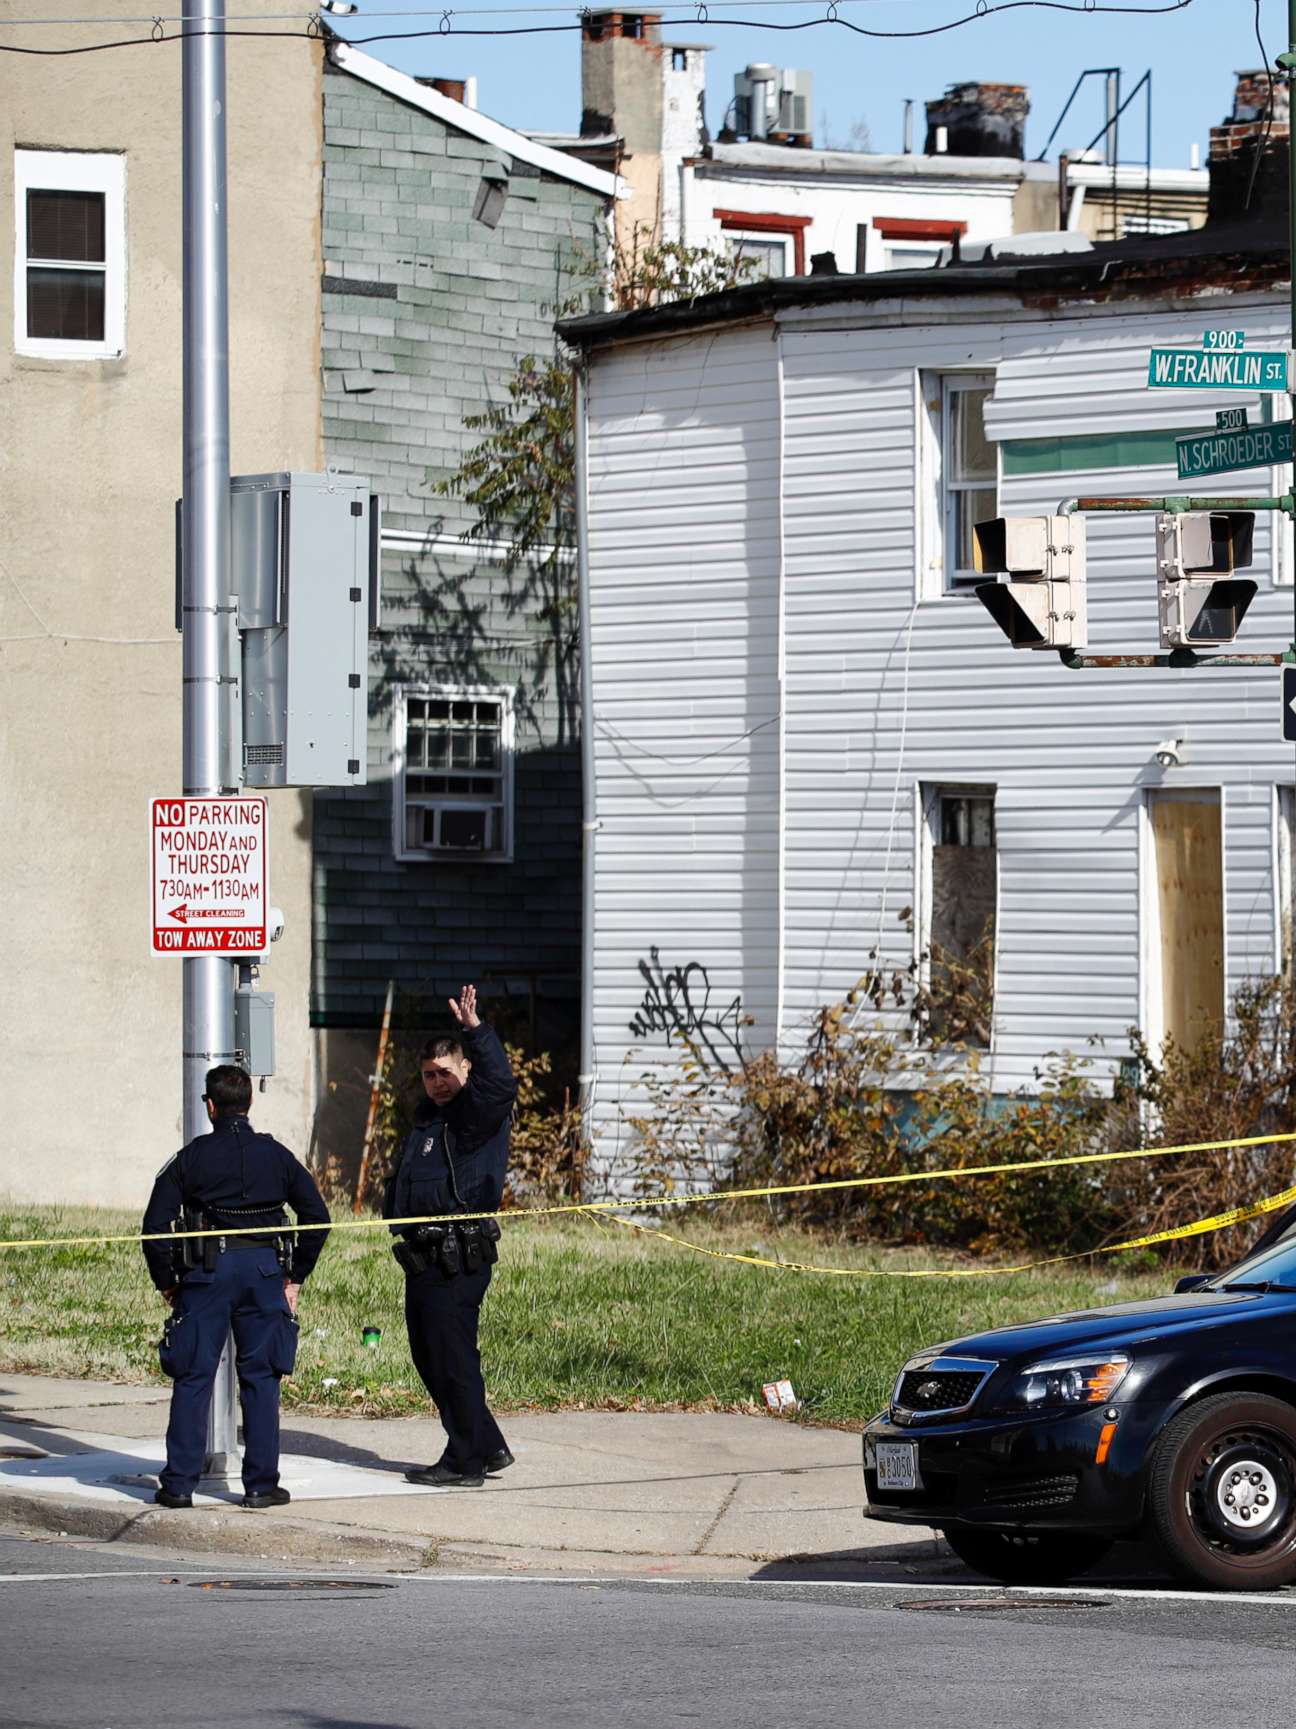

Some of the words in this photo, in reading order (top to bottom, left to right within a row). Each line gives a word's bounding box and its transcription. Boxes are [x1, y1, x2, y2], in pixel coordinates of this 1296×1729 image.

[1208, 331, 1237, 349] 900
[1265, 362, 1283, 380] ST.
[1221, 409, 1243, 429] 500
[155, 803, 184, 826] NO
[189, 804, 261, 825] PARKING
[160, 830, 228, 851] MONDAY
[228, 835, 258, 851] AND
[168, 854, 250, 875] THURSDAY
[175, 910, 205, 918] STREET
[205, 909, 245, 918] CLEANING
[156, 930, 184, 948] TOW
[186, 930, 225, 948] AWAY
[227, 929, 263, 948] ZONE
